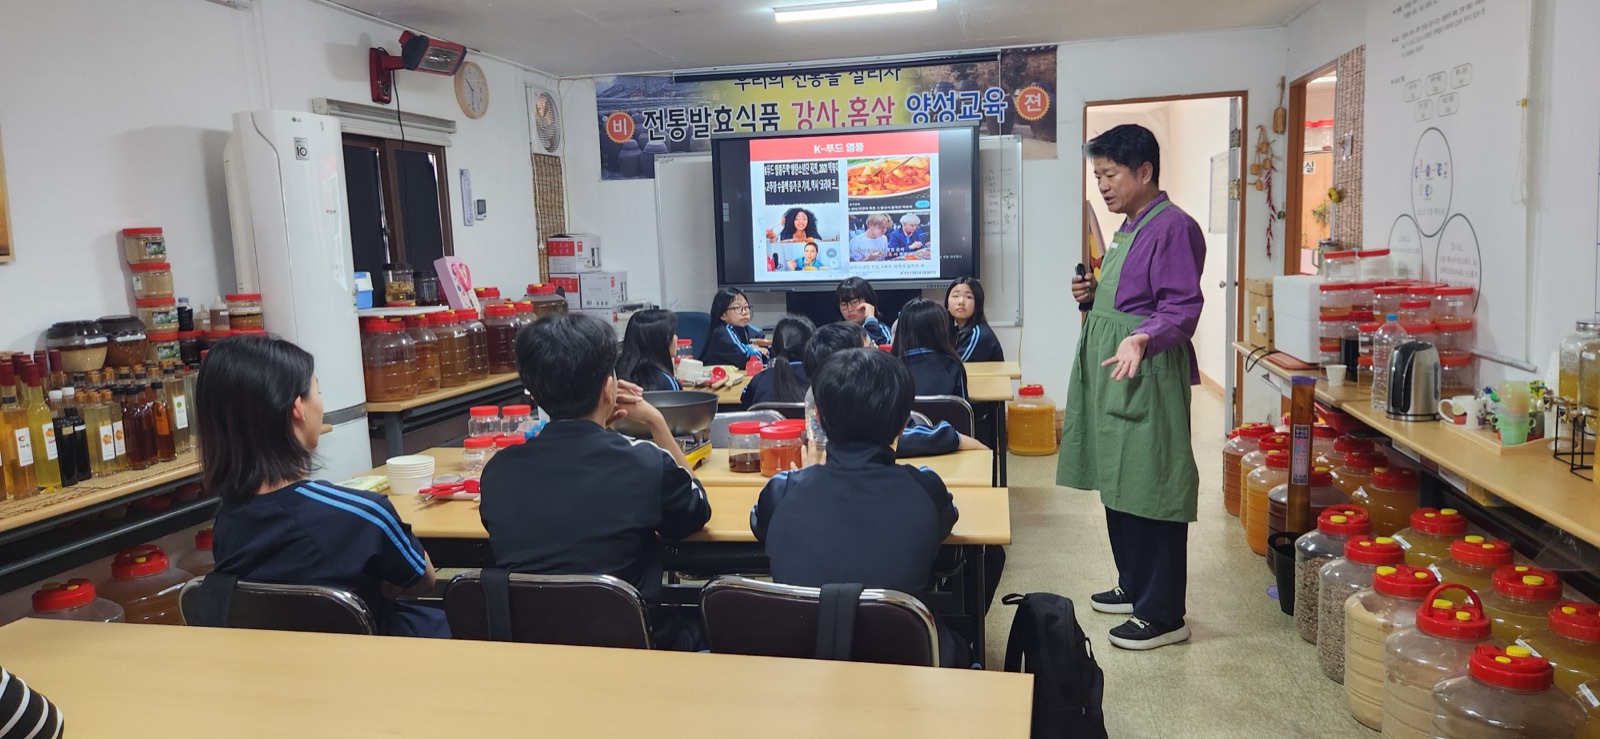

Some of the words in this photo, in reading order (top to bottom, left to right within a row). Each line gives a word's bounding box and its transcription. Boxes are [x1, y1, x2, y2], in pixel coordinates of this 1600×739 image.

[643, 103, 780, 140] 전통발효식품
[906, 87, 1008, 123] 양성교육
[612, 118, 628, 136] 비
[813, 143, 845, 155] K-푸드
[846, 142, 865, 153] 열풍
